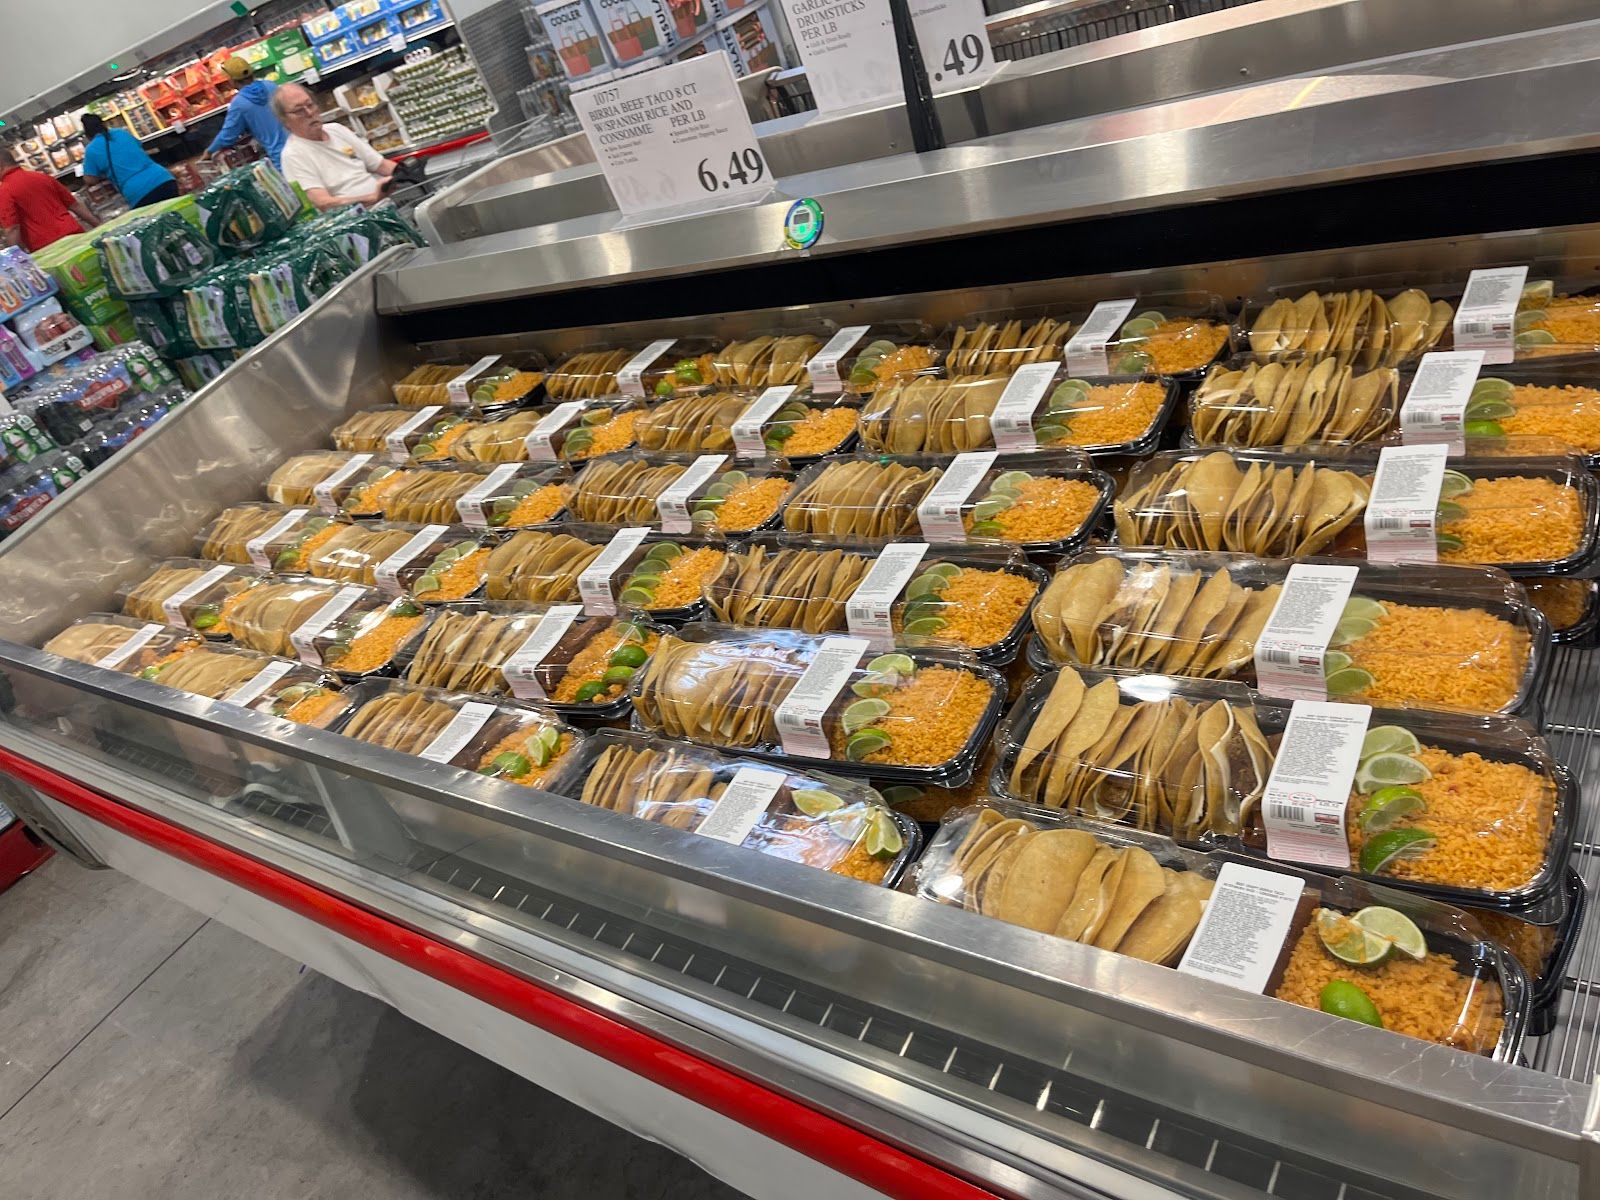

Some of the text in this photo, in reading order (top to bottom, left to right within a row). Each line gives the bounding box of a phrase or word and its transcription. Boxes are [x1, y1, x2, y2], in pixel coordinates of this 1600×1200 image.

[550, 9, 582, 27] COOLER
[796, 0, 866, 28] DRUMSTICKS
[800, 21, 838, 41] PER LB
[934, 34, 984, 82] .49
[588, 82, 697, 122] BIRRIA BEEF TACO 8 CT
[593, 88, 620, 106] 10757
[644, 105, 669, 120] RICE
[671, 99, 693, 114] AND
[670, 109, 706, 127] PER LB
[599, 123, 655, 145] CONSOMME
[698, 148, 764, 192] 6.49
